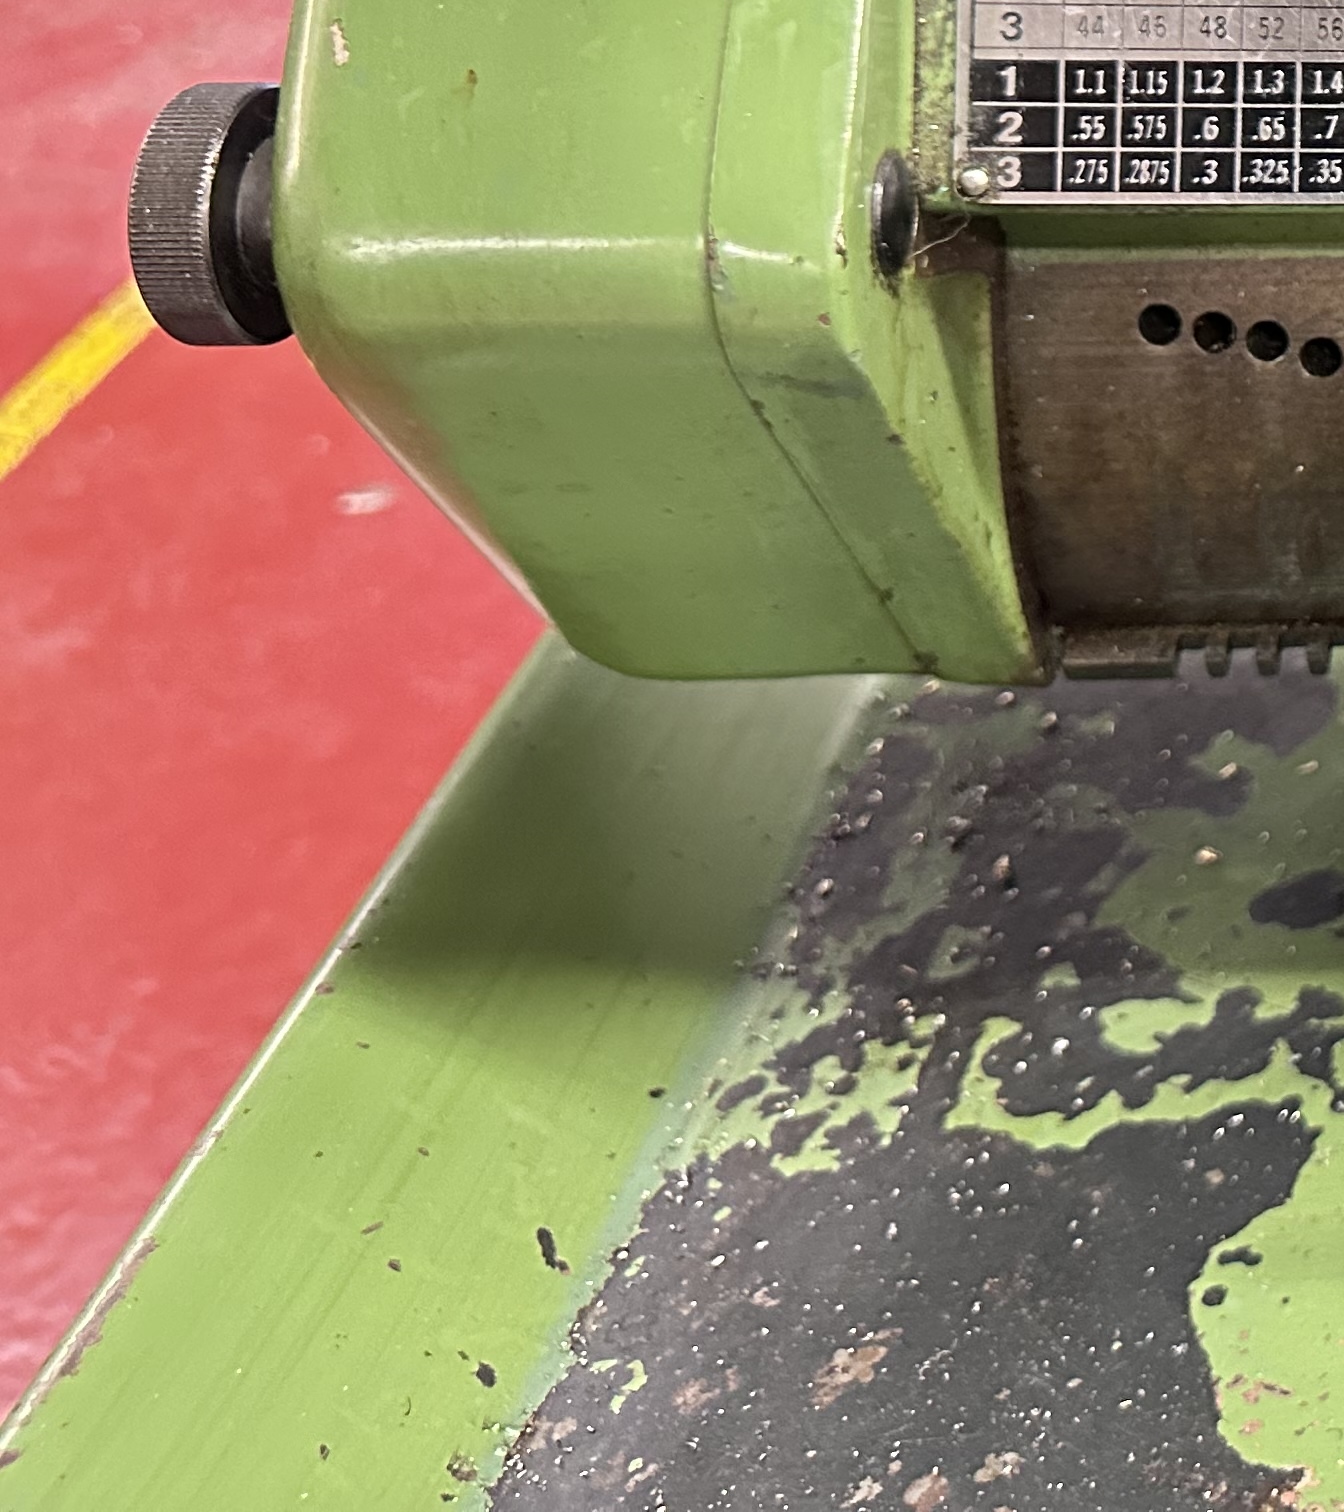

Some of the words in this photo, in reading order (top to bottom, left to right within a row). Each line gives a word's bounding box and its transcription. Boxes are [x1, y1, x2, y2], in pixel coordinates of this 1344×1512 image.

[1000, 12, 1024, 41] 3
[1077, 15, 1105, 37] 44
[1138, 15, 1167, 38] 46
[1200, 16, 1228, 39] 48
[1258, 16, 1285, 40] 52
[1318, 17, 1344, 41] 56
[1000, 66, 1017, 96] 1
[1075, 69, 1107, 94] 1.1
[1129, 69, 1168, 95] 1.15
[1192, 70, 1226, 94] 1.2
[1253, 70, 1285, 94] 1.3
[1314, 70, 1344, 94] 1.4
[996, 111, 1023, 144] 2
[1072, 115, 1106, 140] .55
[1128, 115, 1167, 140] .575
[1194, 115, 1220, 140] .6
[1251, 117, 1286, 140] .65
[1315, 115, 1338, 139] .7
[998, 155, 1023, 188] 3
[1067, 160, 1108, 183] .275
[1125, 159, 1170, 184] .2875
[1193, 160, 1219, 184] .3
[1242, 160, 1289, 184] .325
[1309, 159, 1342, 183] .35
